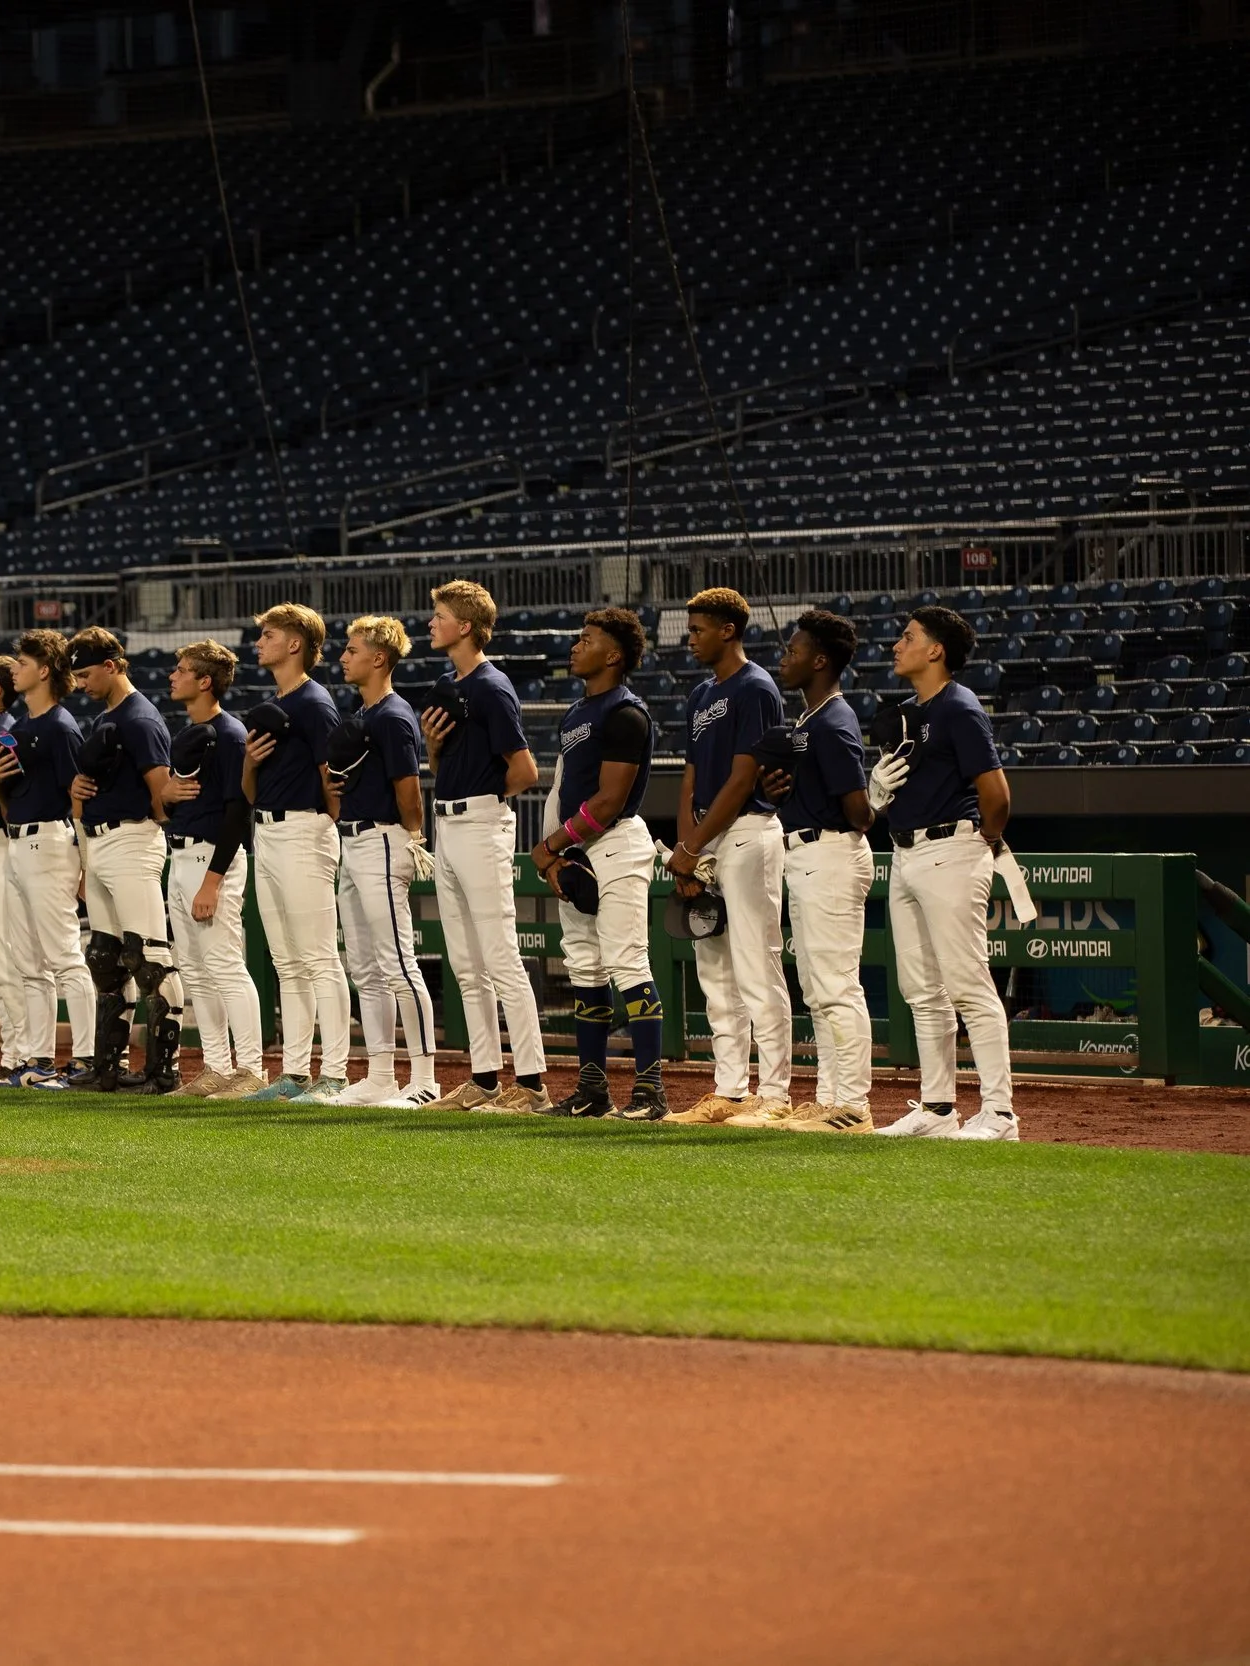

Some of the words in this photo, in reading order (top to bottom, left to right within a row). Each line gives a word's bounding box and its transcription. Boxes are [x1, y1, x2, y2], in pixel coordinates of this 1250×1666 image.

[1032, 866, 1092, 884] HYUNDAI
[518, 933, 546, 949] NDAI
[1051, 940, 1111, 957] HYUNDAI
